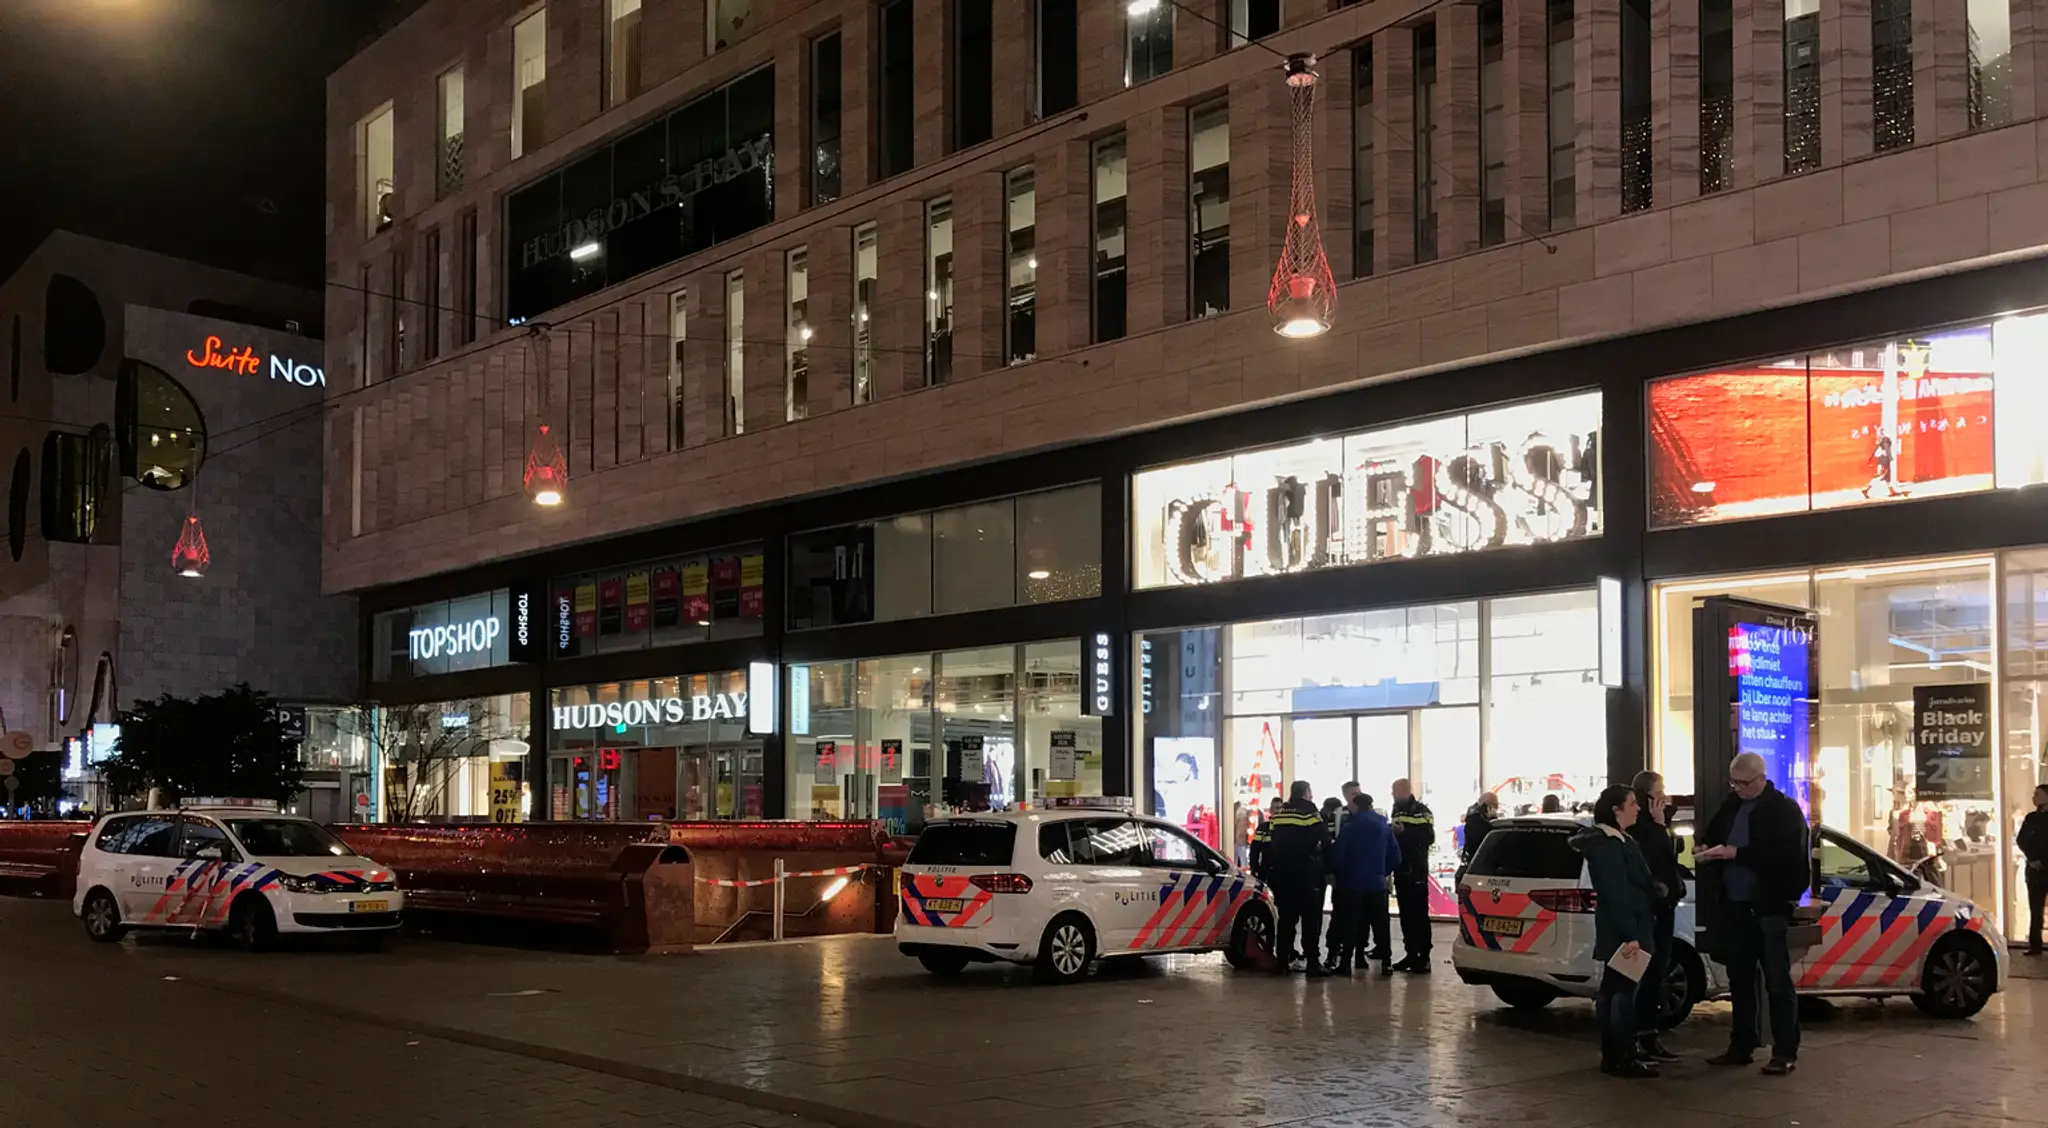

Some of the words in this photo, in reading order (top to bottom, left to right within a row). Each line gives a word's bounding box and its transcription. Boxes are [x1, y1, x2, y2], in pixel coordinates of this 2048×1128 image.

[521, 173, 682, 269] HUDSON'S
[692, 132, 773, 193] BAY
[186, 335, 261, 377] Suite
[1162, 430, 1590, 585] GUESS
[517, 592, 529, 647] TOPSHOP
[409, 616, 500, 660] TOPSHOP
[1096, 633, 1110, 712] GUESS
[1742, 674, 1764, 688] zitten
[1764, 675, 1803, 691] chauffeurs
[1742, 689, 1752, 706] bij
[1753, 690, 1772, 705] Uber
[1772, 693, 1792, 707] nooit
[279, 710, 291, 724] P
[553, 697, 685, 730] HUDSON'S
[692, 692, 748, 721] BAY
[1742, 708, 1751, 721] te
[1752, 709, 1769, 725] lang
[1770, 710, 1793, 724] achter
[1922, 709, 1983, 727] Black
[1742, 725, 1756, 739] het
[1920, 728, 1985, 746] friday
[496, 808, 517, 823] OFF
[1487, 878, 1511, 887] POLITIE
